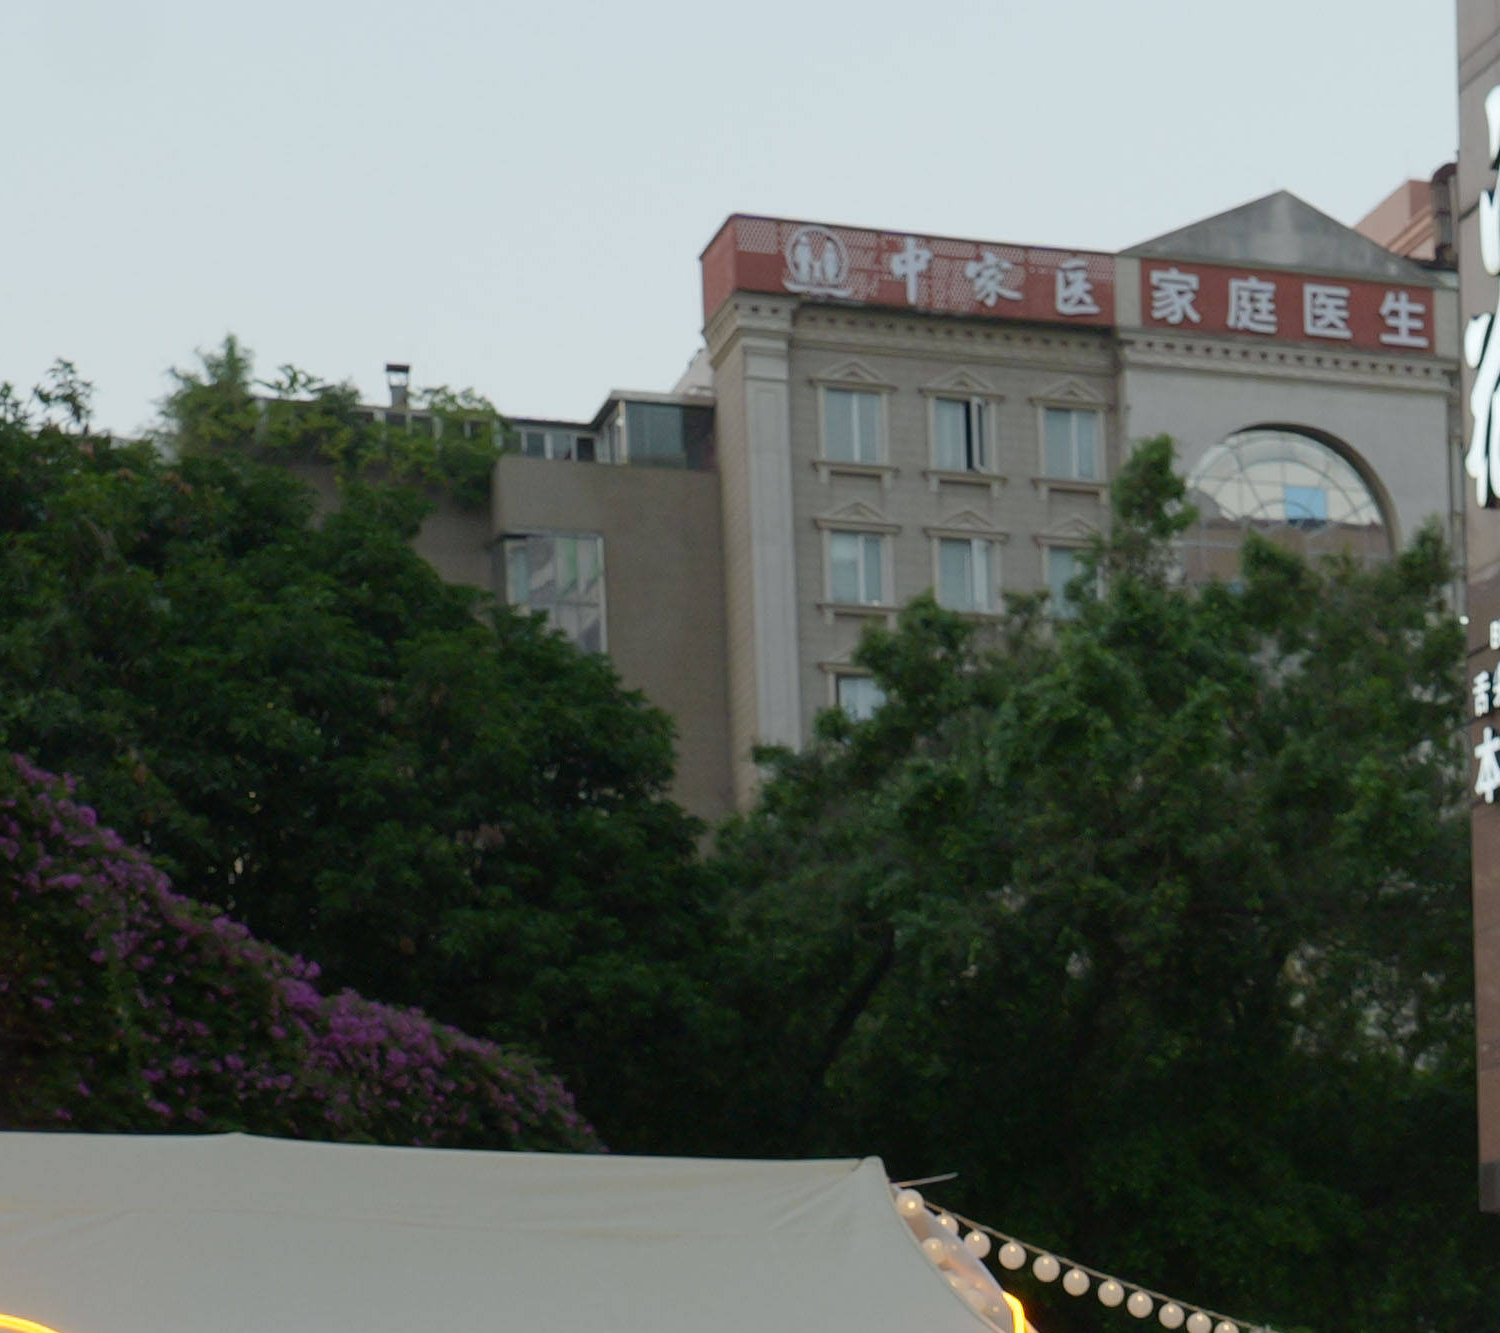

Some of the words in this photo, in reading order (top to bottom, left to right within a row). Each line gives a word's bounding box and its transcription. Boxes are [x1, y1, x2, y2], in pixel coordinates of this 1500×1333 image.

[890, 236, 1101, 318] 中家医
[1148, 267, 1432, 350] 家庭医生
